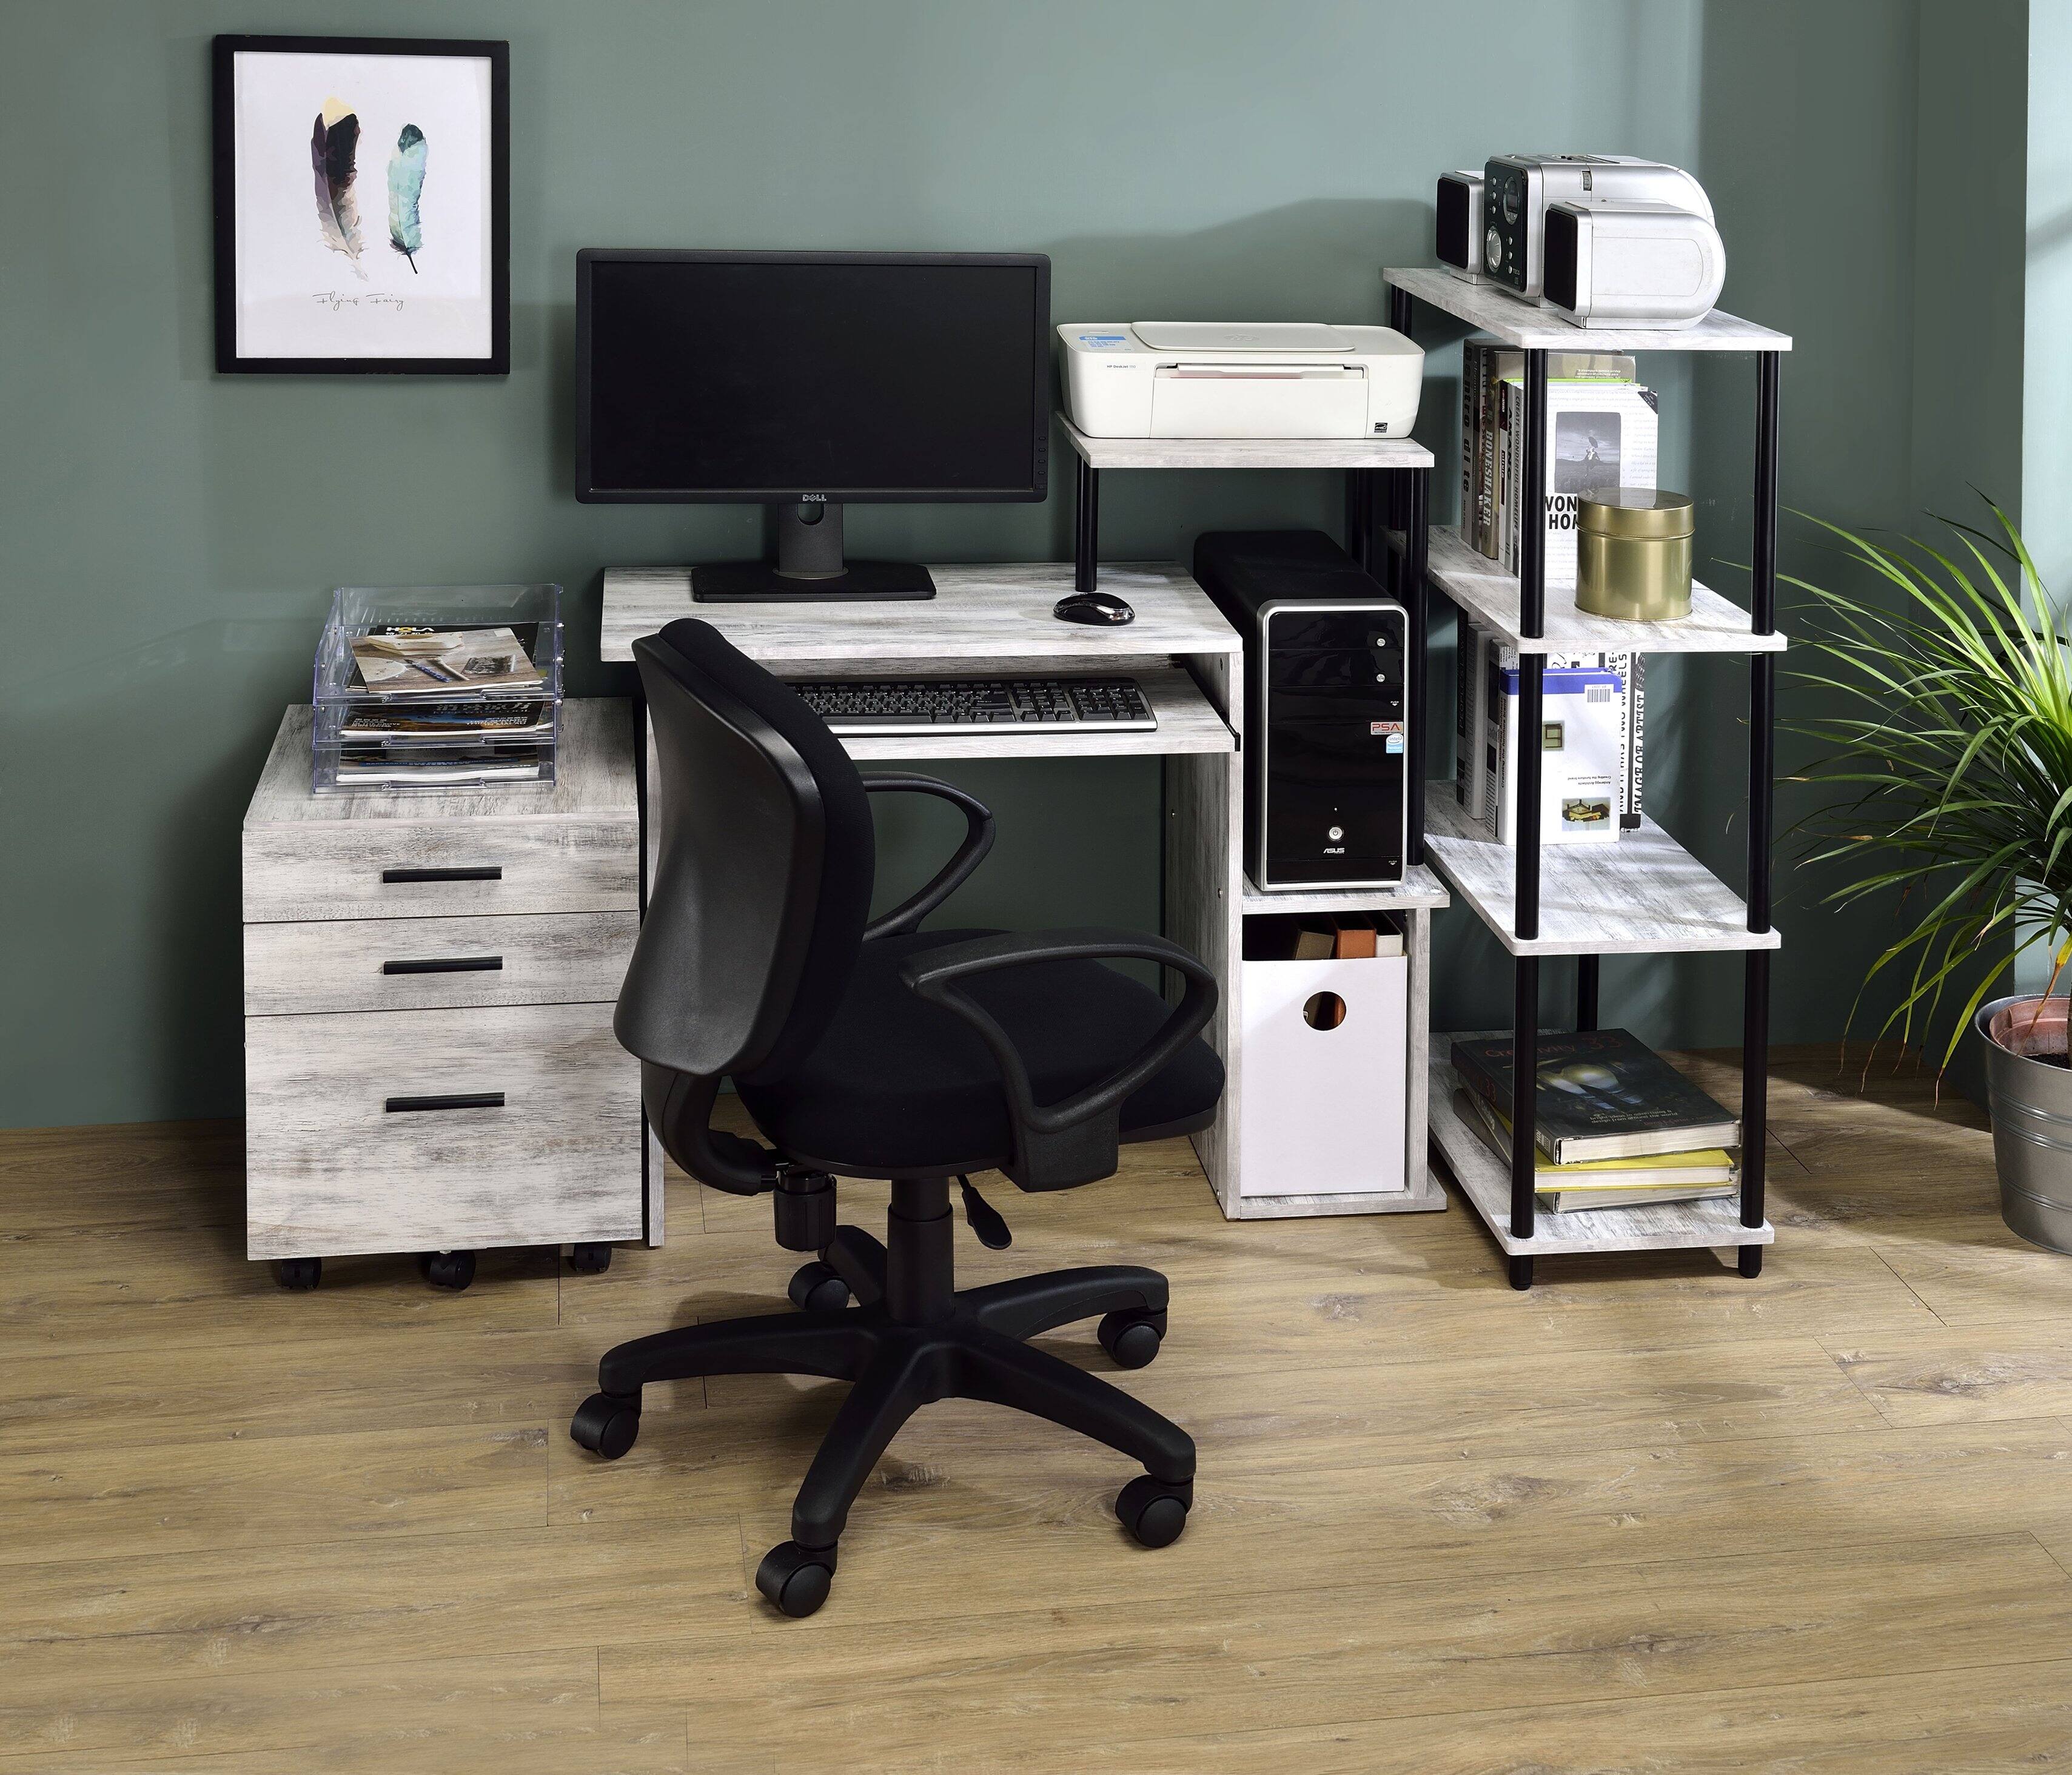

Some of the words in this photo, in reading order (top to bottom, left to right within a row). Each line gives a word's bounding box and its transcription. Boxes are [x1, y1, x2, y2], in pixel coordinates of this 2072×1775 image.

[312, 290, 360, 311] Flying
[366, 294, 404, 311] Fairy
[1463, 470, 1470, 492] te
[1483, 431, 1493, 526] BONESHAKER
[1372, 723, 1400, 731] PSA
